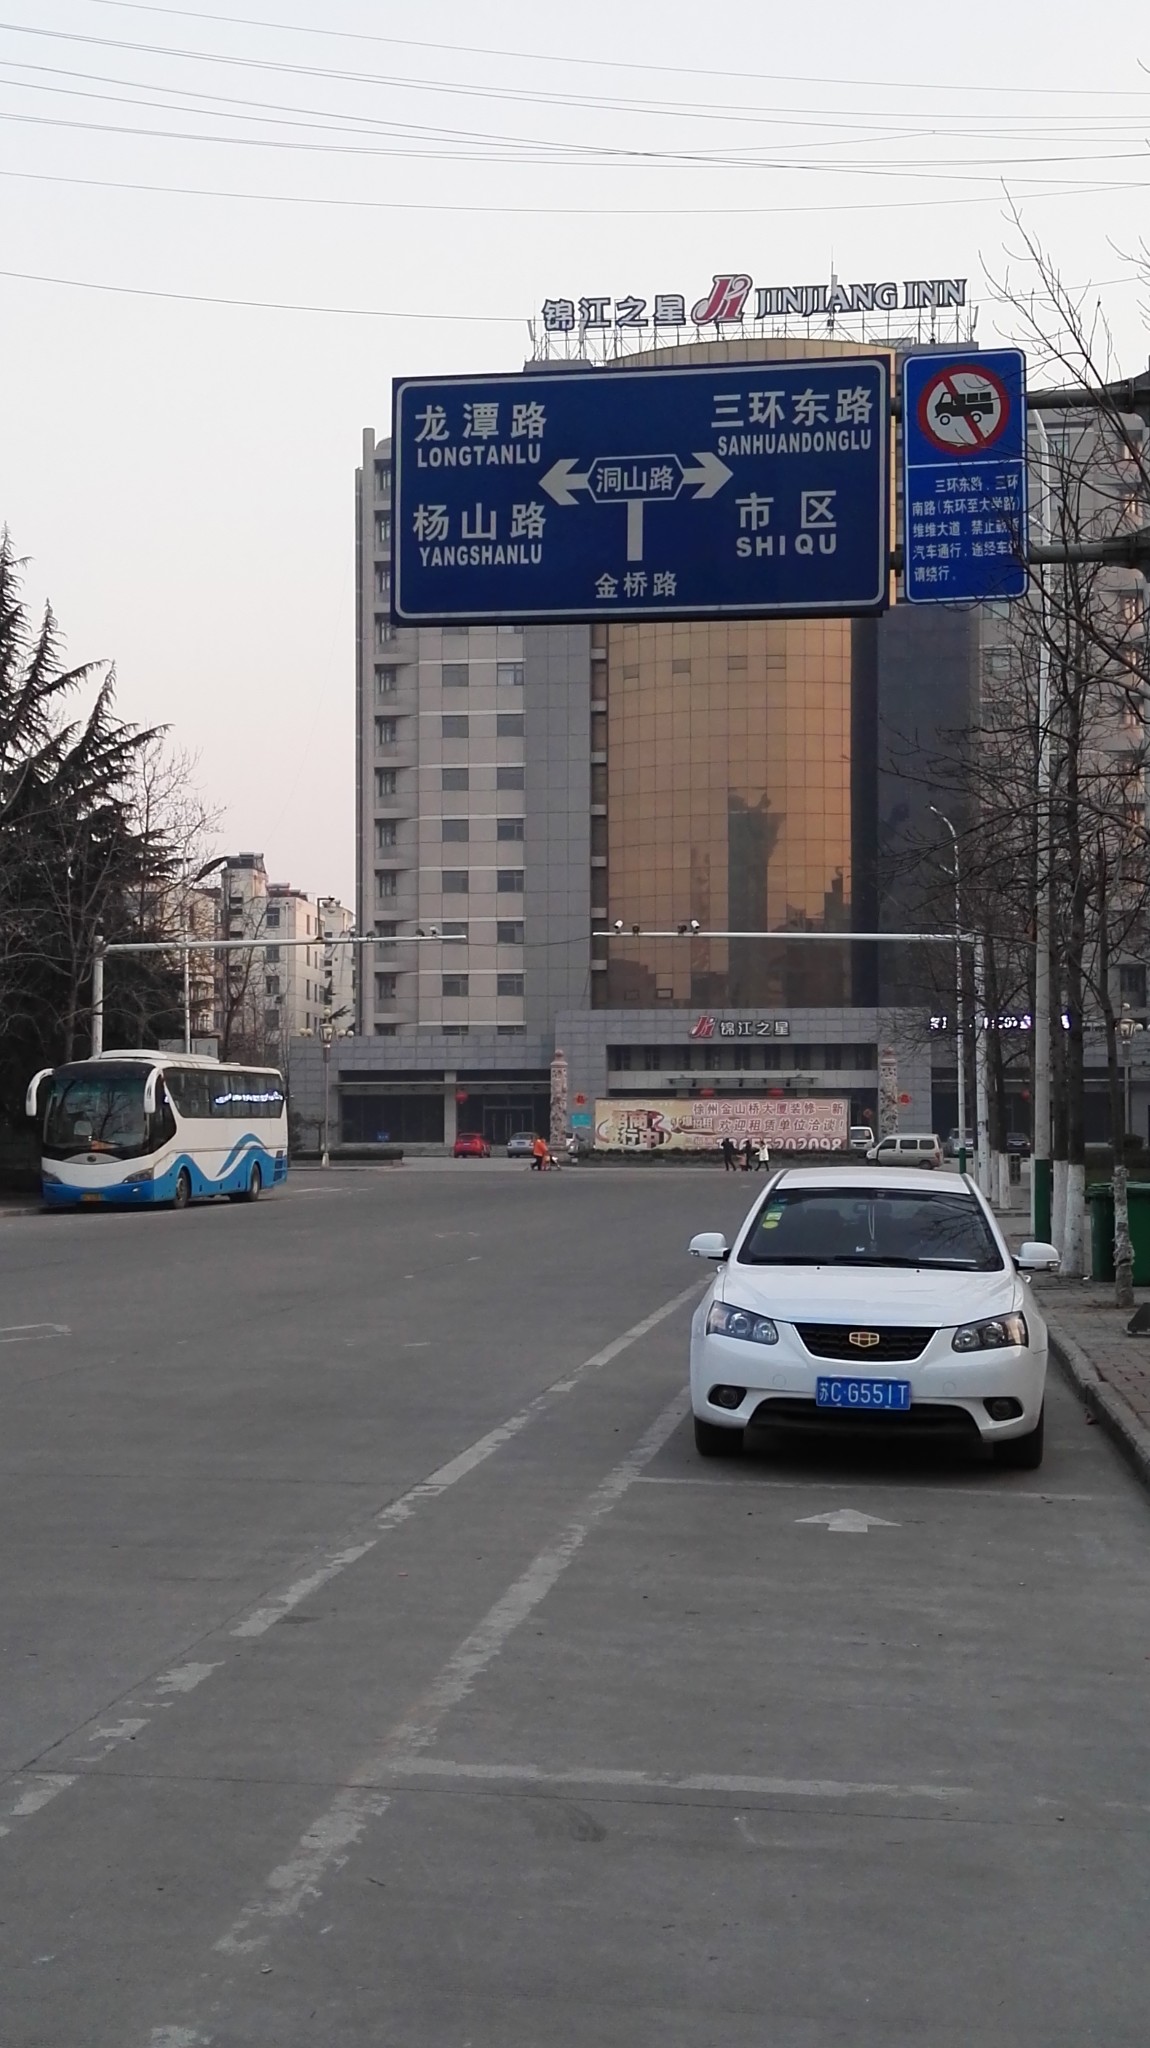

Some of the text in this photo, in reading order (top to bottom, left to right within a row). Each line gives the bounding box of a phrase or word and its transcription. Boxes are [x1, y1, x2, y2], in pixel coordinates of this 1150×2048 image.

[755, 279, 967, 317] JINJIANG INN
[542, 294, 686, 331] 锦江之星
[711, 386, 873, 428] 三环东路
[414, 400, 547, 444] 龙潭路
[417, 443, 542, 468] LONGTANLU
[718, 430, 872, 456] SANHUANDONGLU
[596, 465, 674, 493] 洞山路
[413, 501, 547, 543] 杨山路
[736, 491, 838, 531] 市区
[419, 543, 543, 567] YANGSHANLU
[594, 571, 678, 599] 金桥路
[720, 1020, 789, 1036] 锦江之星
[693, 1101, 844, 1115] 徐州金山桥大厦装修一新
